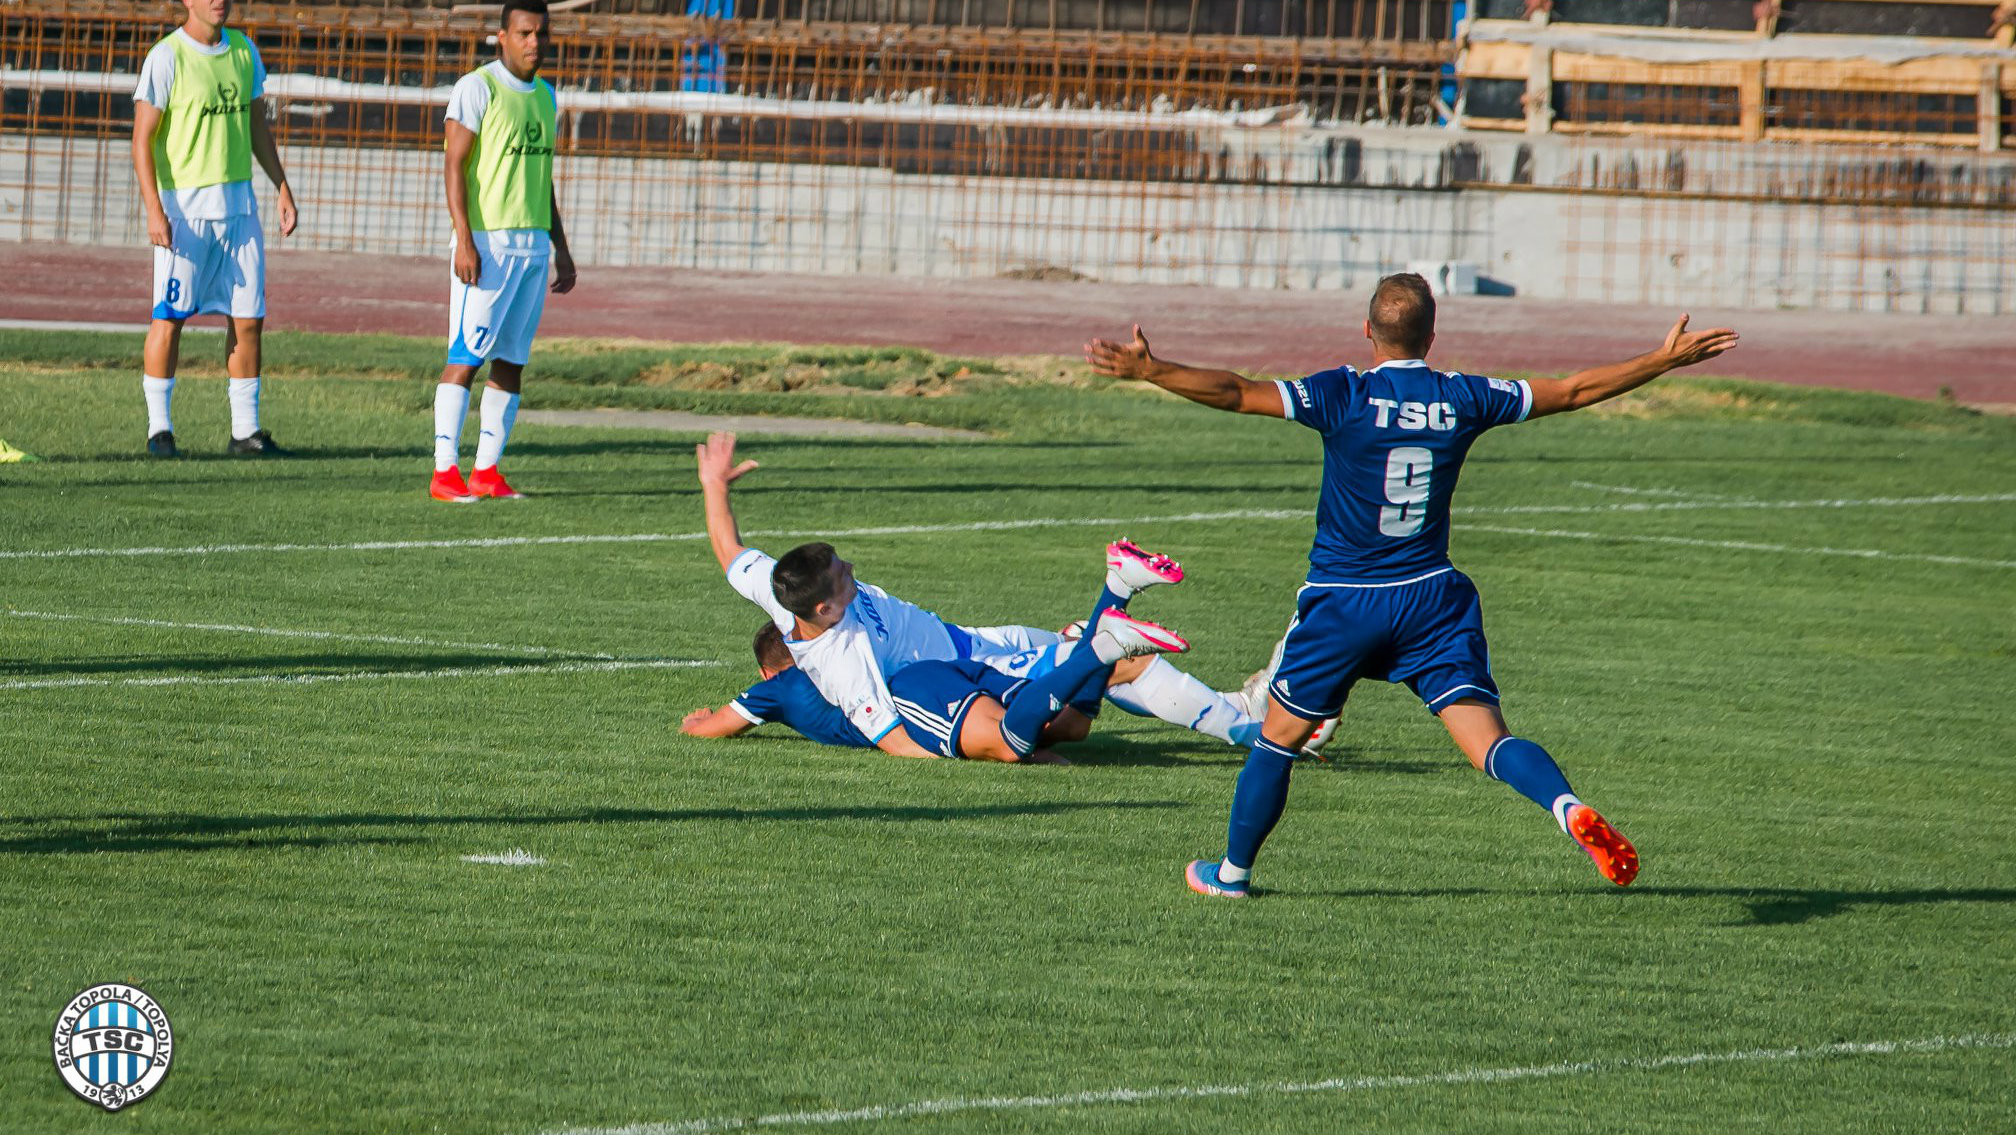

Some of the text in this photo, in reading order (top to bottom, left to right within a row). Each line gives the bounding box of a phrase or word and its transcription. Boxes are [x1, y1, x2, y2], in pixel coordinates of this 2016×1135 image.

[166, 278, 181, 303] 8
[474, 326, 489, 349] 7
[1369, 397, 1457, 431] TSC
[1379, 446, 1433, 537] 9
